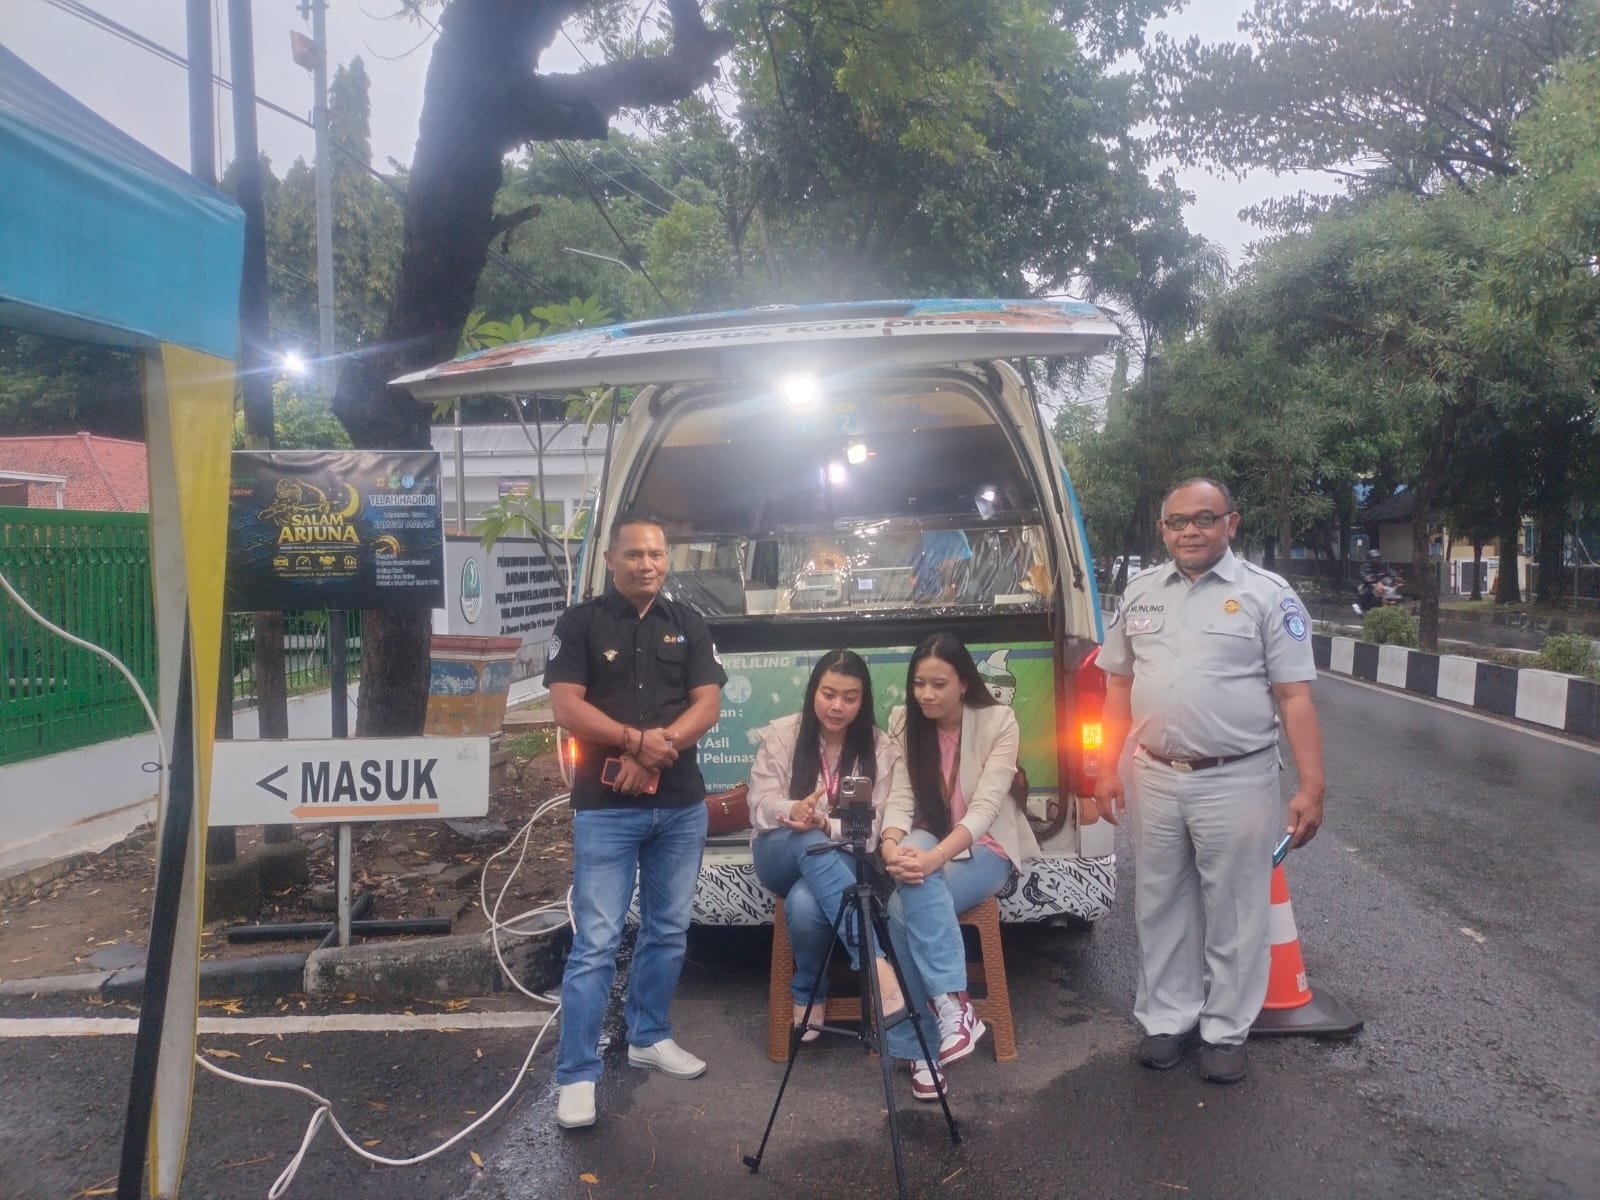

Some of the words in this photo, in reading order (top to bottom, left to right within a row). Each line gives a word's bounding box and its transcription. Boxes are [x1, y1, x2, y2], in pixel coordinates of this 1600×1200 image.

[369, 494, 398, 507] TELAH
[399, 494, 428, 506] HADIR
[291, 513, 344, 526] SALAM
[277, 525, 360, 545] ARJUNA
[1130, 604, 1164, 613] NUNUNG
[723, 656, 790, 669] KELILING
[704, 737, 730, 749] Asli
[703, 752, 755, 764] Pelunas
[301, 758, 439, 804] MASUK
